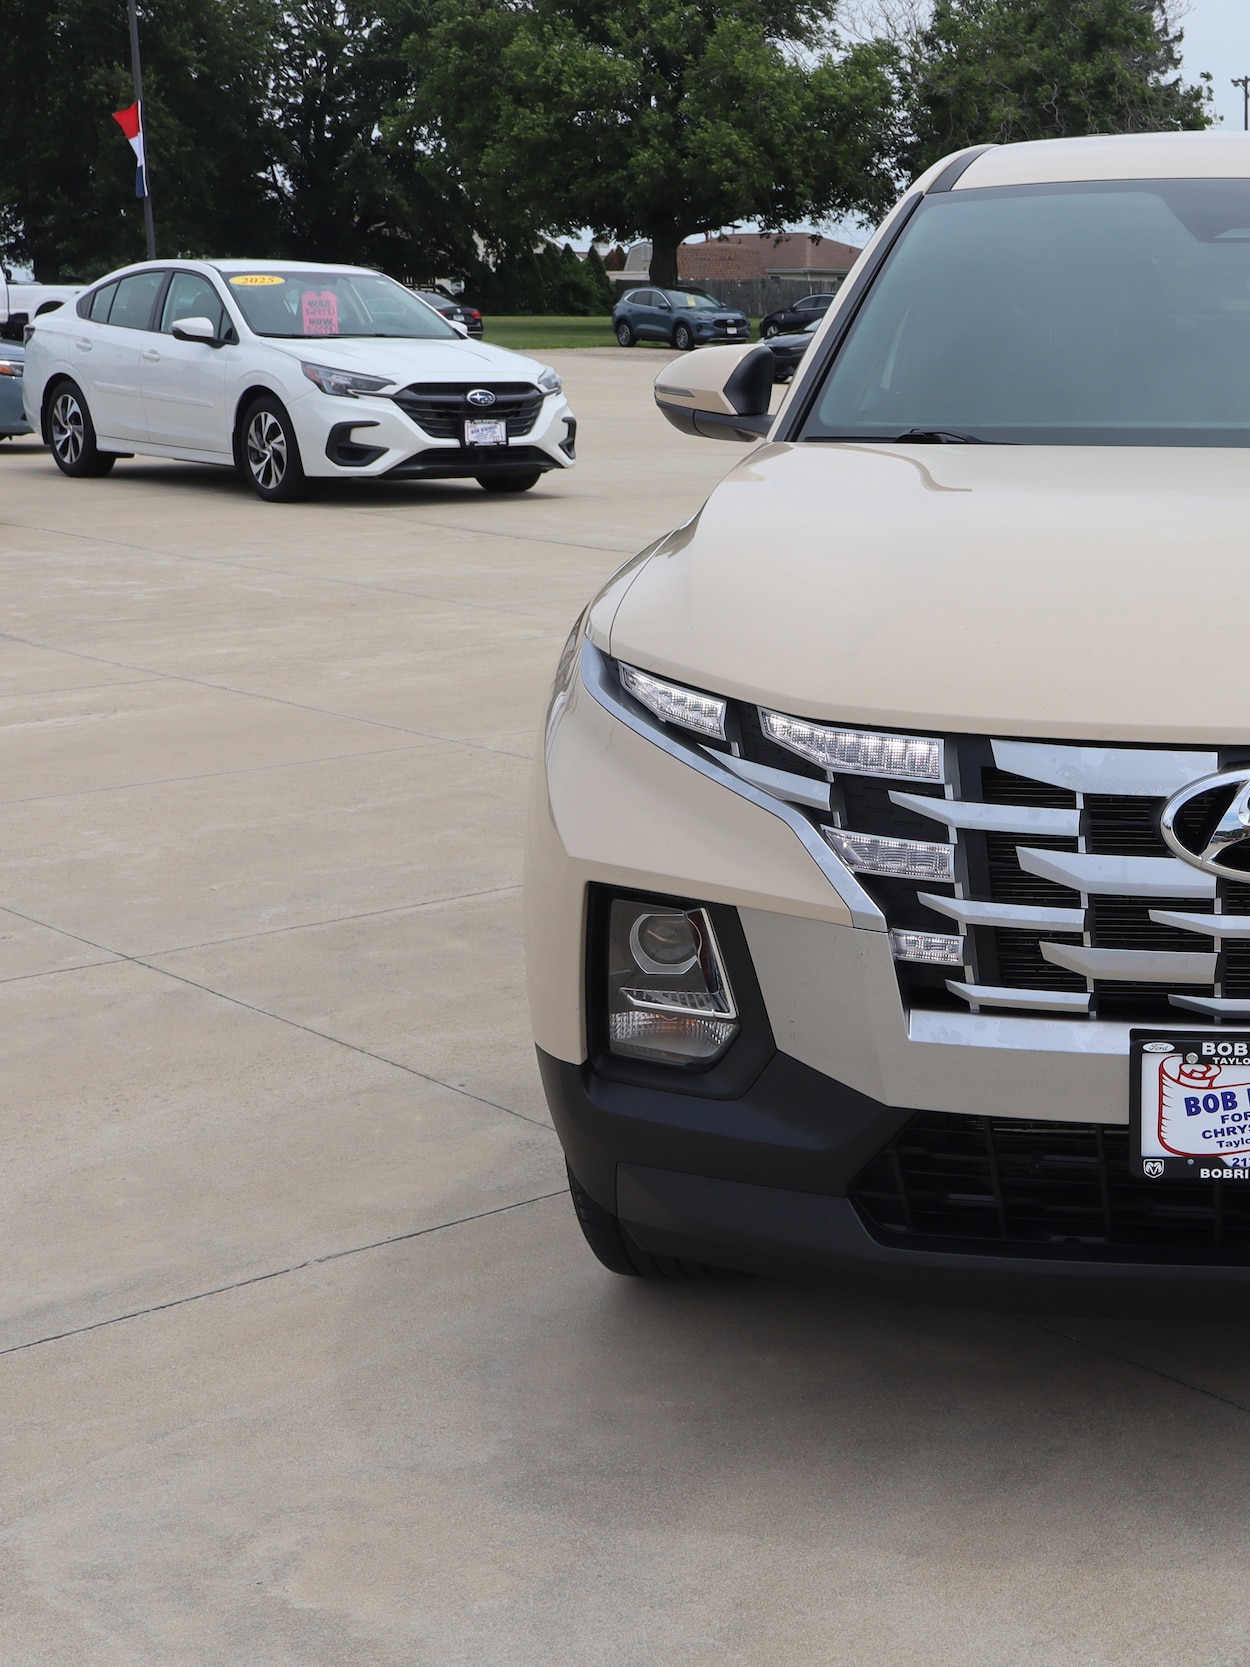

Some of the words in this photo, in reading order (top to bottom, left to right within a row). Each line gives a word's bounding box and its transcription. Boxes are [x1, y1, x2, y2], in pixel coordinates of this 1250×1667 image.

[241, 277, 275, 285] 2025
[309, 318, 333, 326] NOW
[1149, 1043, 1170, 1052] Ford
[1201, 1042, 1249, 1057] BOB
[1184, 1090, 1239, 1117] BOB
